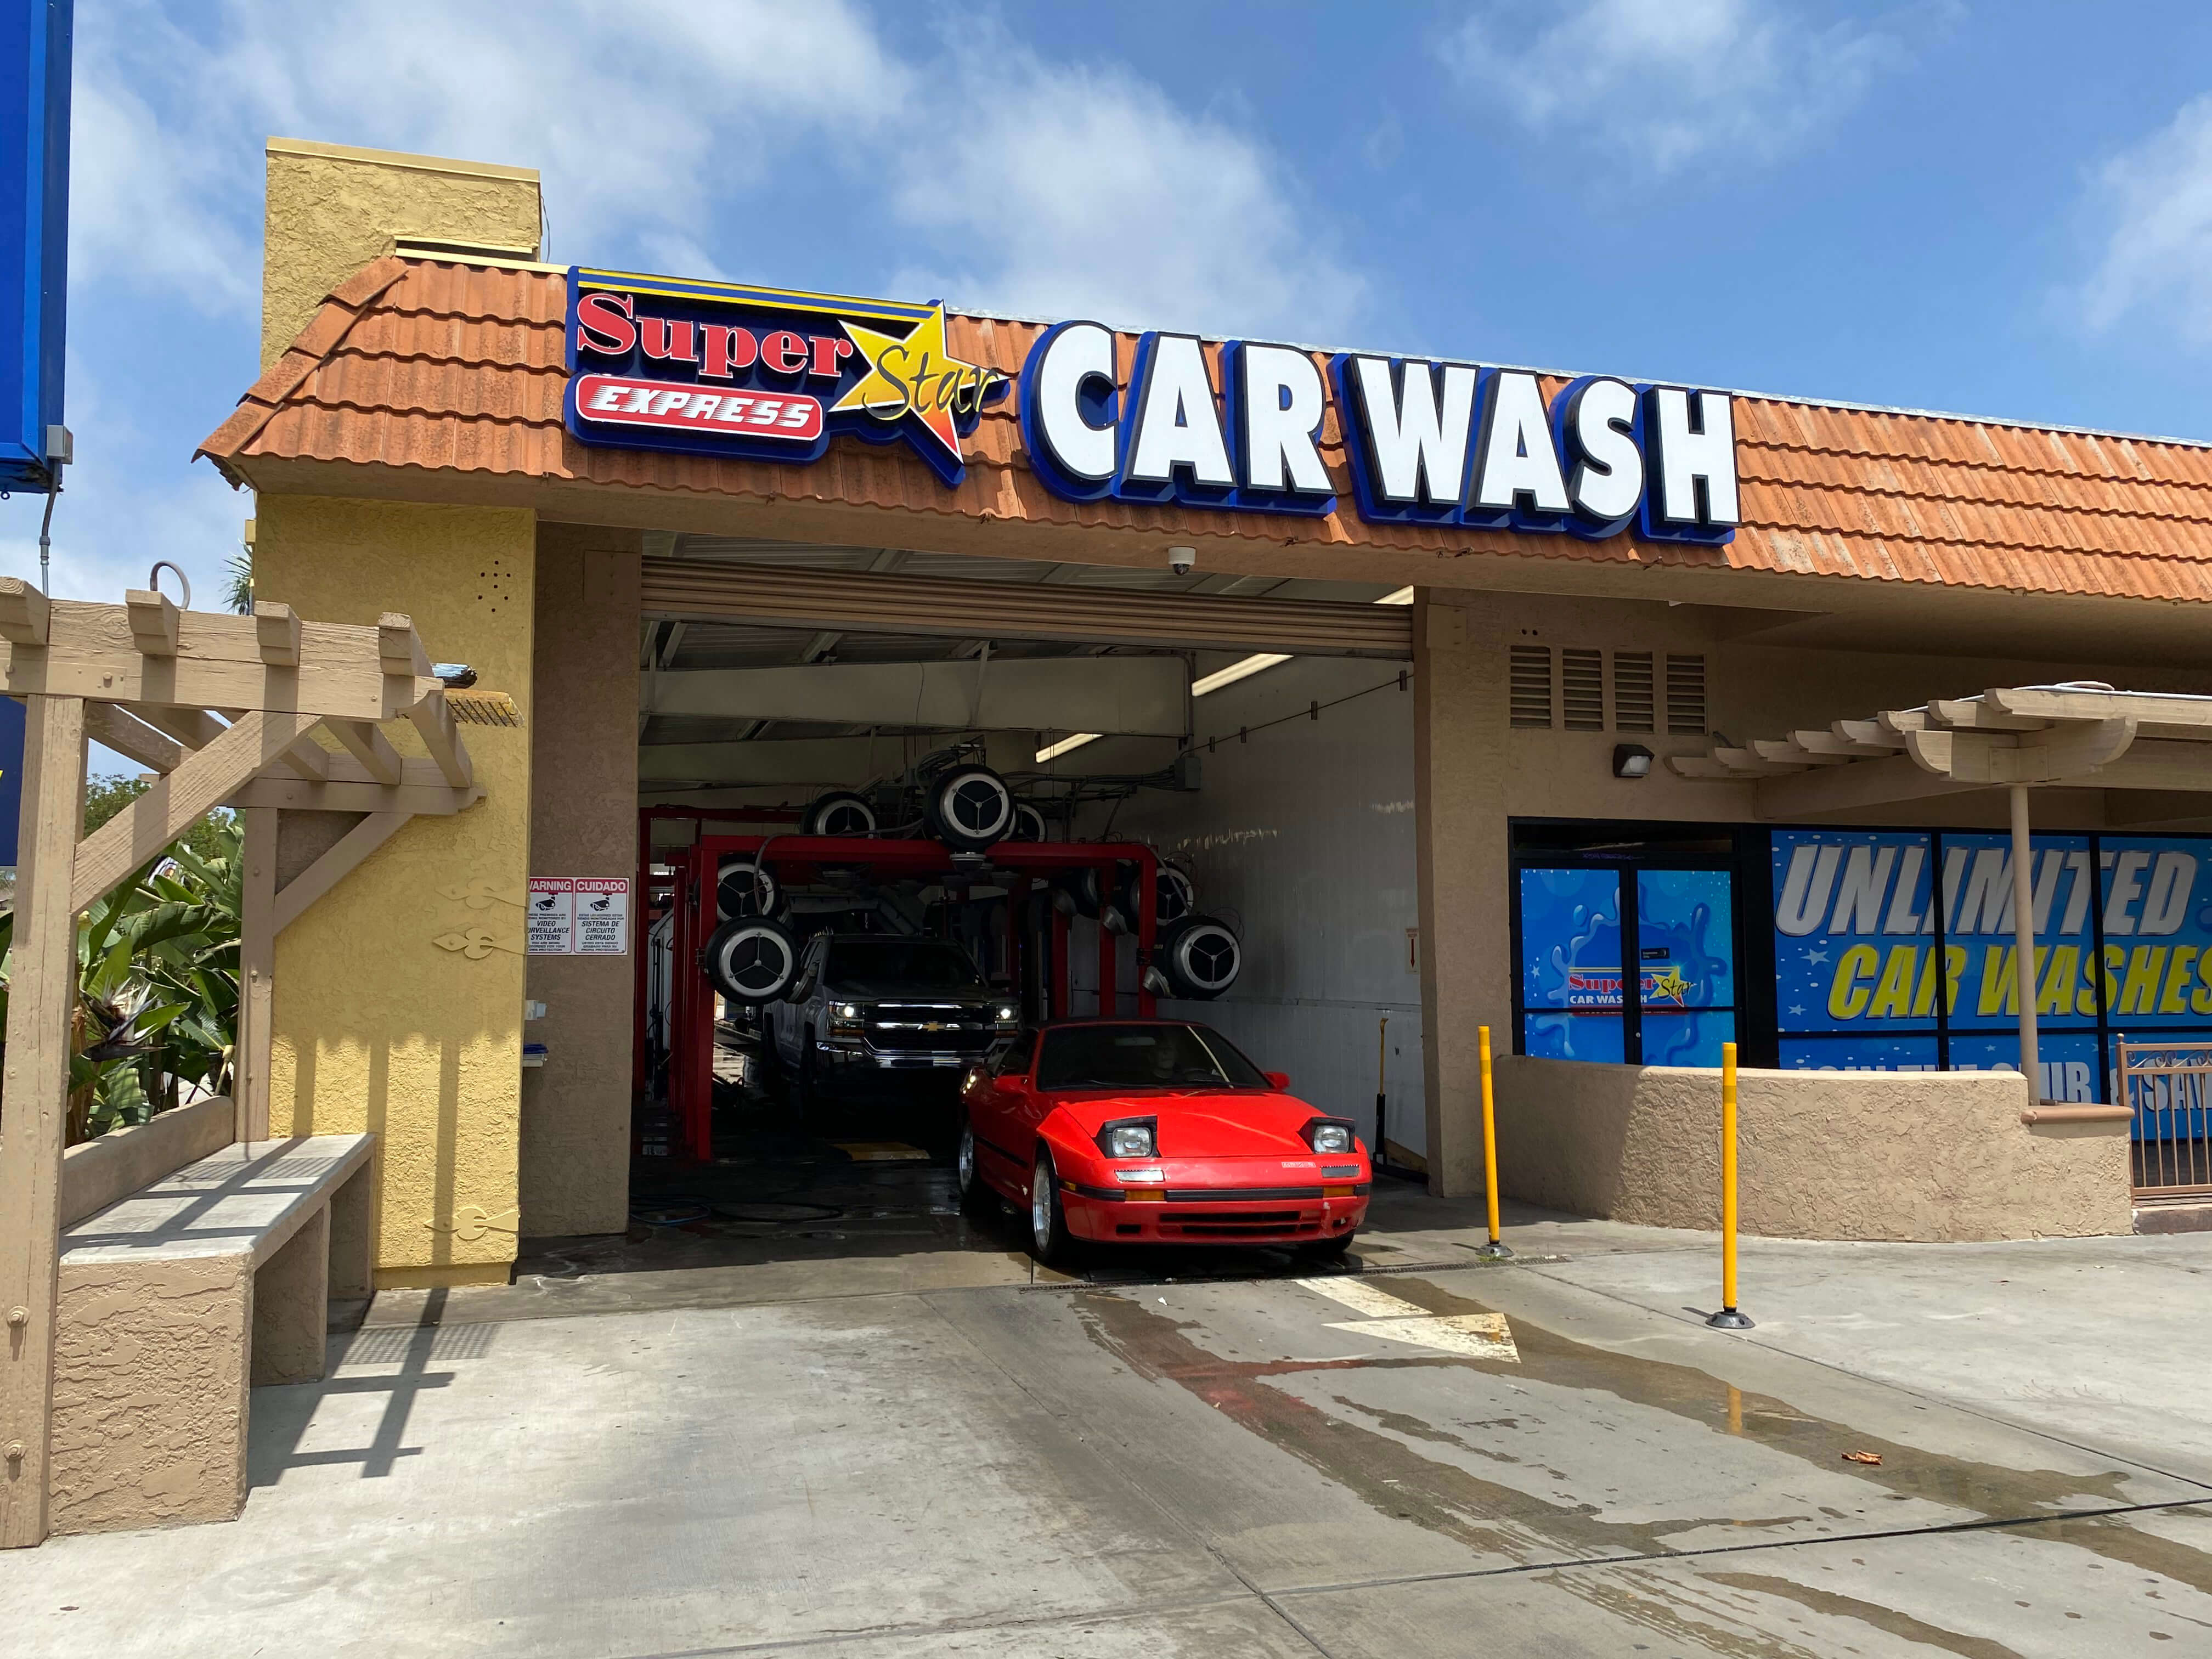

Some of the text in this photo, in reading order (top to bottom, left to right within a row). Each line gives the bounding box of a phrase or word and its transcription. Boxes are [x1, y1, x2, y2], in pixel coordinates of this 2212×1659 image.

[577, 292, 853, 379] Super
[587, 386, 814, 429] EXPRESS
[863, 345, 998, 420] Star
[1035, 320, 1742, 527] CAR WASH
[577, 882, 625, 891] CUIDADO
[1775, 844, 2197, 936] UNLIMITED
[1569, 974, 1657, 994] Super
[1570, 995, 1647, 1004] CAR WASH
[1657, 978, 1694, 999] Star
[1827, 944, 1968, 1020] CAR
